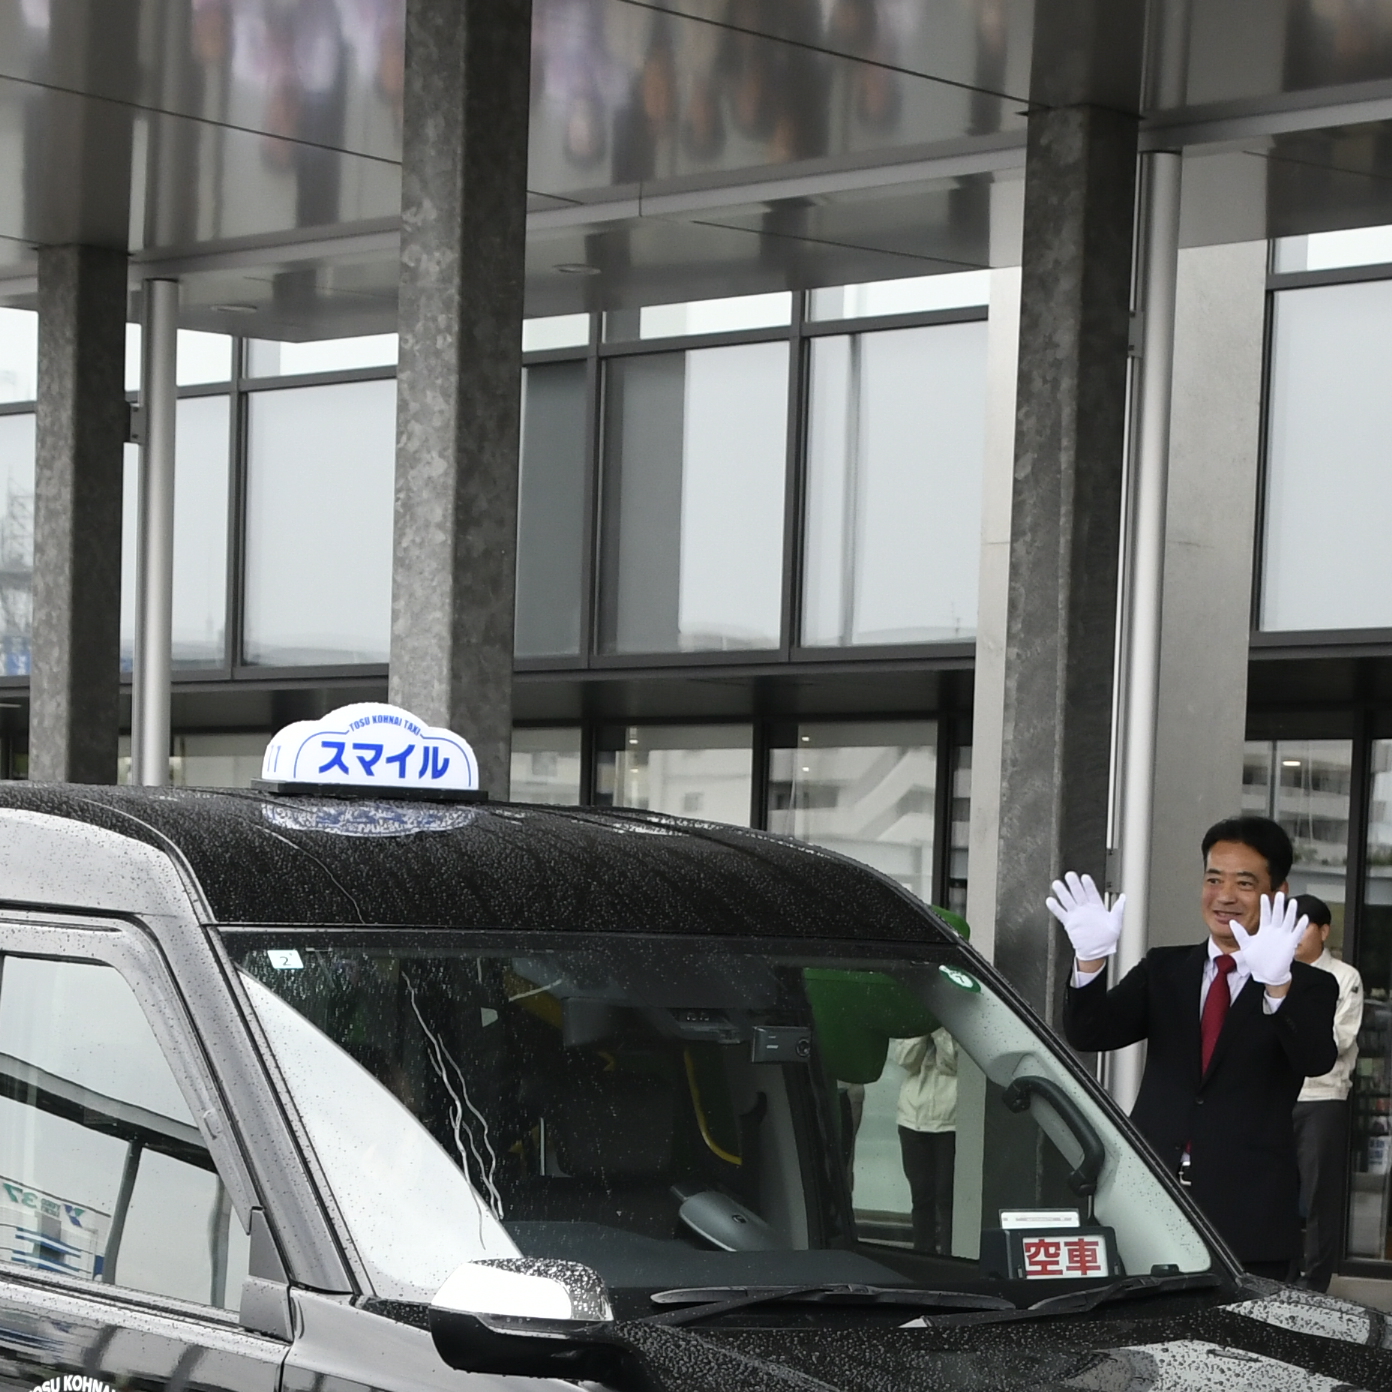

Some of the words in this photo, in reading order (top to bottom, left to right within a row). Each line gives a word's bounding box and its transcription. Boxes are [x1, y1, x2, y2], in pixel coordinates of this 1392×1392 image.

[349, 715, 371, 732] TOSU
[372, 714, 403, 727] KOHNAI
[404, 719, 422, 736] TAXI
[318, 740, 450, 780] スマイル
[1024, 1238, 1102, 1276] 空車
